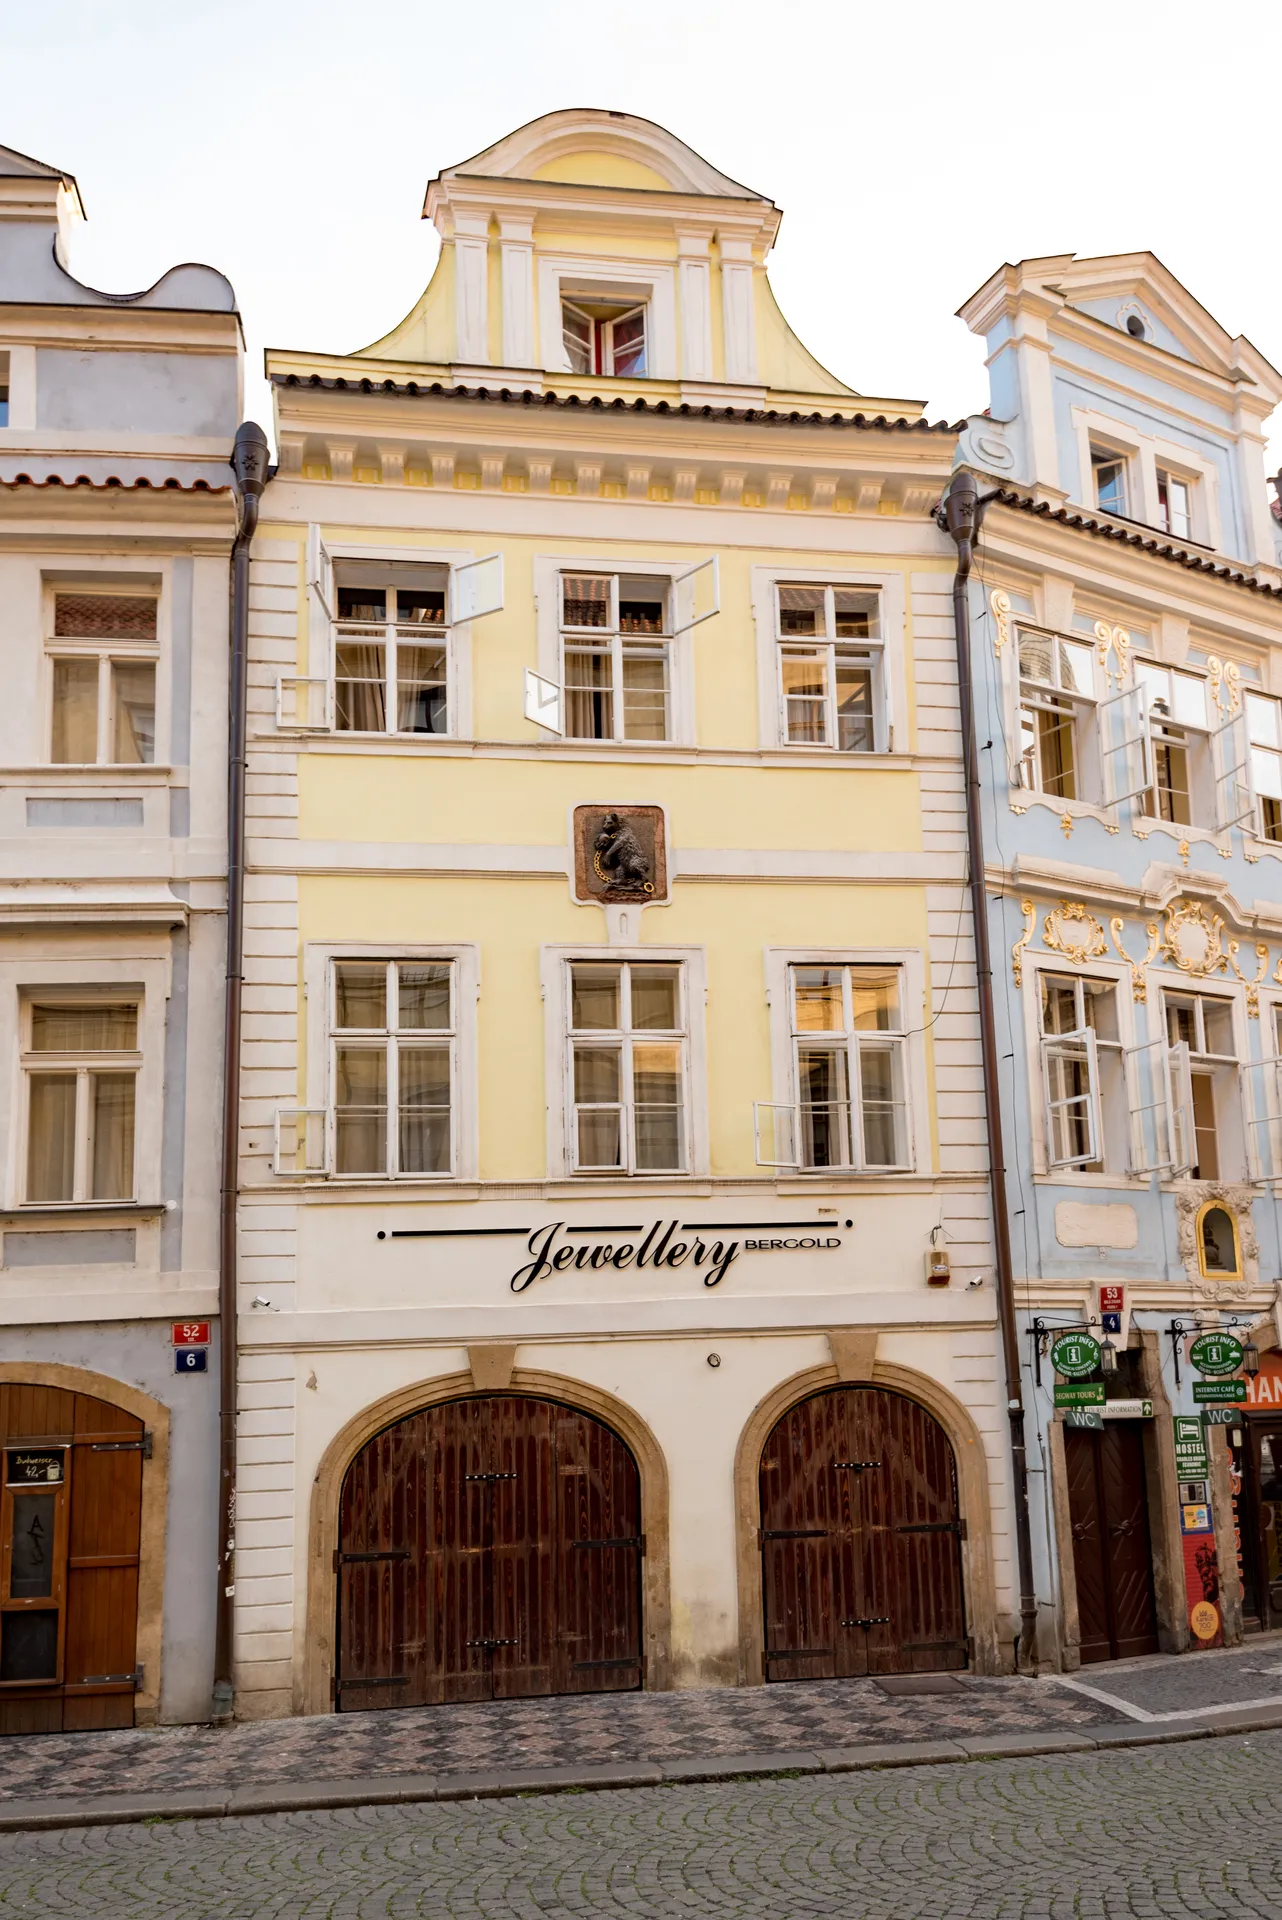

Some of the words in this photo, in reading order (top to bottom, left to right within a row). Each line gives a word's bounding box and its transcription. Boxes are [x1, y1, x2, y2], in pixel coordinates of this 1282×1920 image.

[510, 1220, 739, 1292] Jewellery
[744, 1237, 842, 1250] BERGOLD
[1106, 1287, 1118, 1299] 53
[1109, 1316, 1116, 1329] 4
[183, 1324, 200, 1337] 52
[1054, 1335, 1079, 1351] TOURIST
[1079, 1335, 1095, 1349] INFO
[1193, 1335, 1219, 1351] TOURIST
[1220, 1335, 1237, 1348] INFO
[186, 1353, 196, 1367] 6
[1055, 1392, 1076, 1400] SEGWAY
[1077, 1391, 1096, 1399] TOURS
[1220, 1385, 1235, 1393] CAFÉ
[1229, 1376, 1282, 1403] HAN
[1107, 1405, 1142, 1413] INFORMATION
[1071, 1412, 1095, 1427] WC
[1207, 1409, 1233, 1424] WC
[1175, 1442, 1206, 1454] HOSTEL
